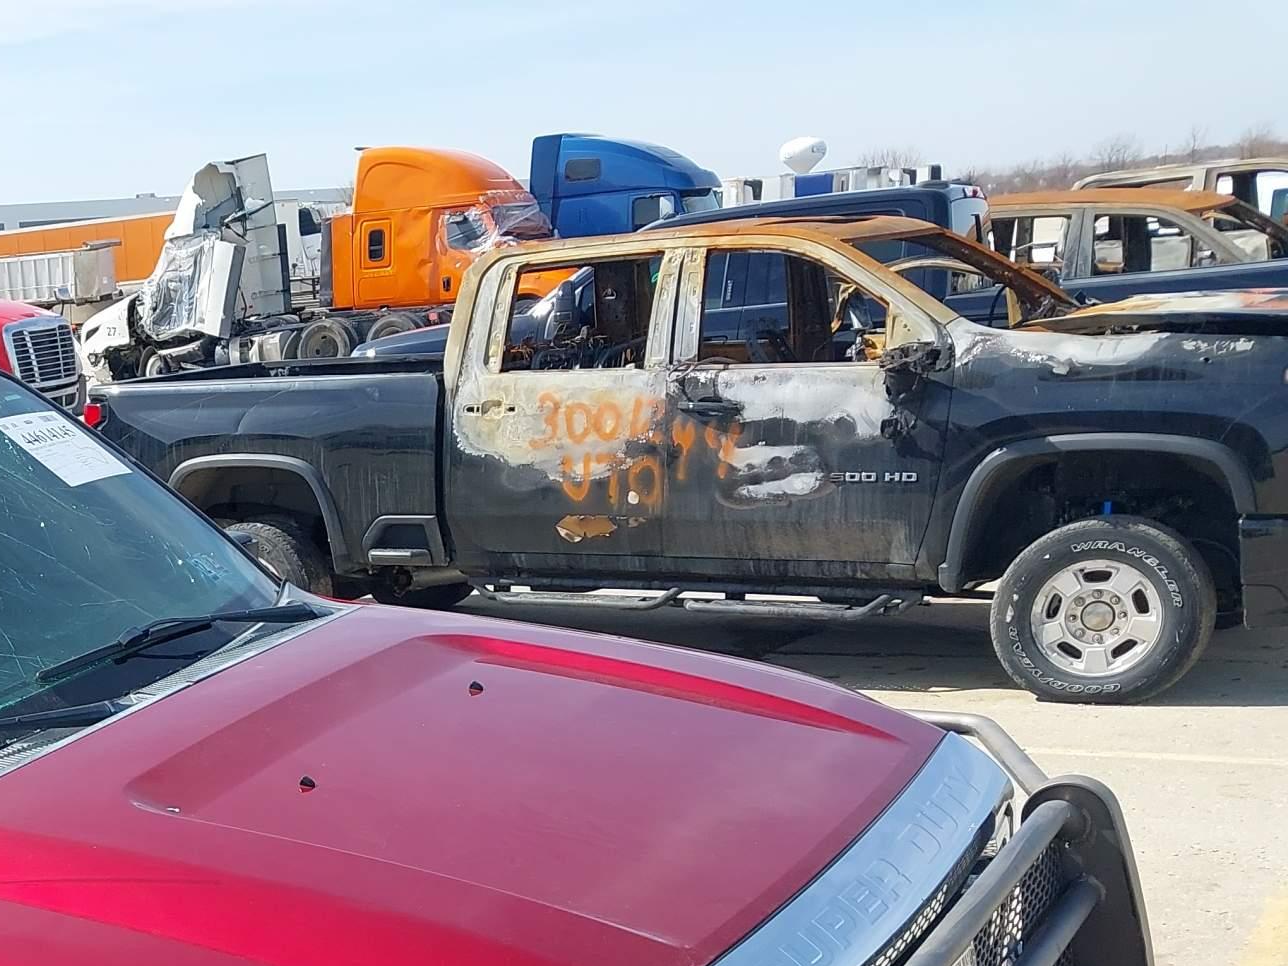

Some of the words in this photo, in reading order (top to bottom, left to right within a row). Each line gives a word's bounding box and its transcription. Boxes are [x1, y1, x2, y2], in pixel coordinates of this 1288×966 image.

[20, 425, 77, 447] 44614145
[884, 471, 918, 483] HD
[1070, 540, 1184, 608] WRANGLER
[1009, 625, 1121, 693] GOODYEAR
[896, 765, 982, 865] DUTY
